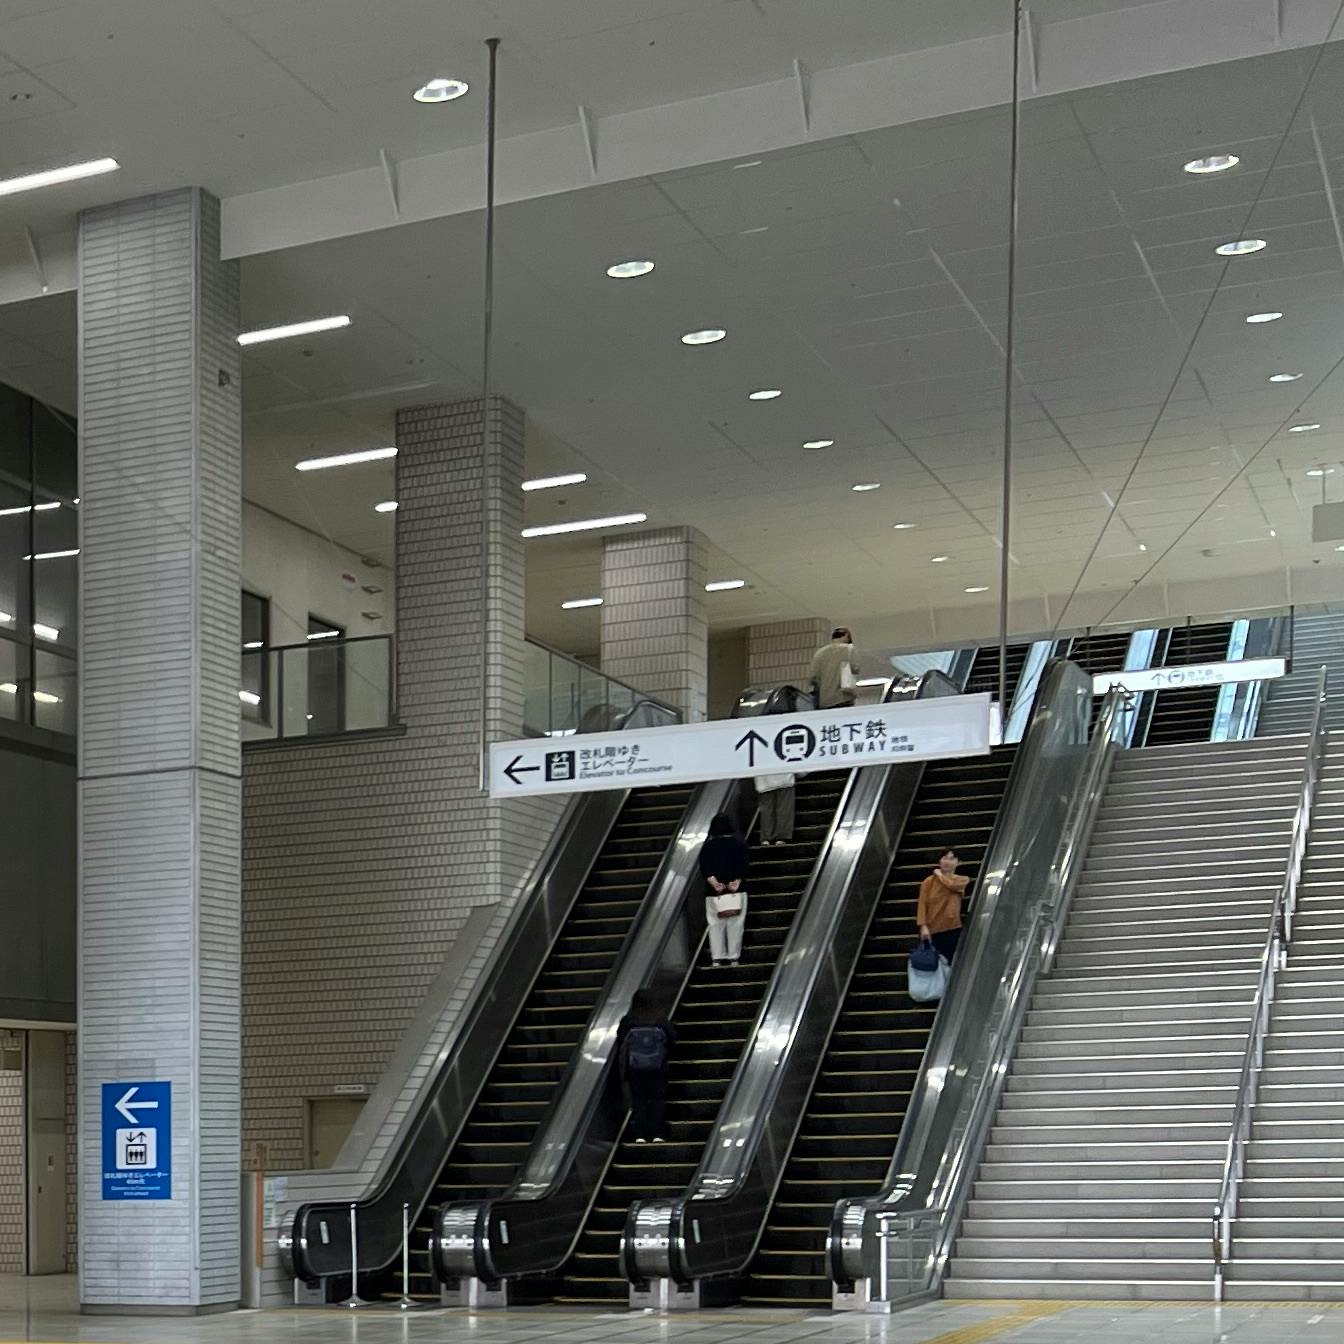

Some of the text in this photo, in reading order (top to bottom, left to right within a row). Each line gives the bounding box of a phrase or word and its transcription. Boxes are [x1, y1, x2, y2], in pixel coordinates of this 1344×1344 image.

[820, 719, 887, 742] 地下鉄
[819, 739, 887, 757] SUBWAY
